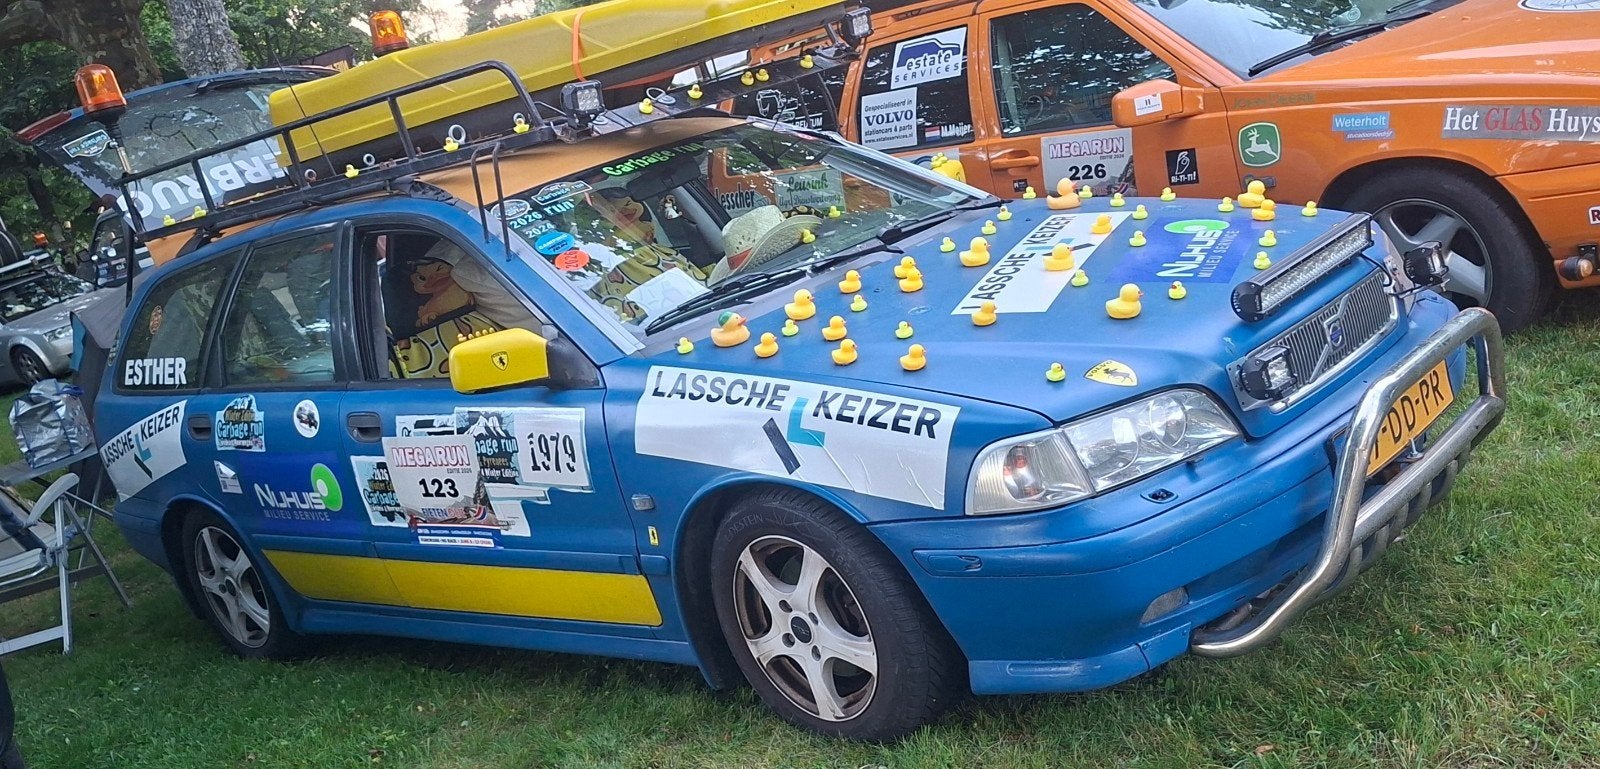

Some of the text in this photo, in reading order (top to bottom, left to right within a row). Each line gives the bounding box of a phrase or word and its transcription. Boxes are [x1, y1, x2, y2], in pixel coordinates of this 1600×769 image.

[907, 52, 951, 71] estate
[895, 62, 960, 83] SERVICES
[864, 100, 906, 113] Gespecialiseerd
[864, 109, 914, 127] VOLVO
[1334, 114, 1387, 129] Weterholt
[1443, 107, 1480, 131] Het
[1484, 107, 1542, 132] GLAS
[864, 127, 893, 137] stationcars
[899, 123, 913, 133] parts
[1049, 137, 1125, 159] MEGARUN
[1068, 163, 1107, 180] 226
[509, 212, 543, 230] 2026
[543, 200, 576, 217] run
[524, 222, 555, 239] 2024
[1022, 215, 1078, 246] KEIZER
[1197, 230, 1241, 278] MILIEU SERVICE
[124, 357, 187, 386] ESTHER
[1087, 361, 1113, 377] VOLVO
[651, 370, 942, 439] LASSCHE KEIZER
[104, 405, 181, 469] LASSCHE KEIZER
[500, 437, 519, 454] run
[391, 445, 471, 468] MEGARUN
[418, 477, 459, 498] 123
[263, 509, 331, 522] MILIEU SERVICE
